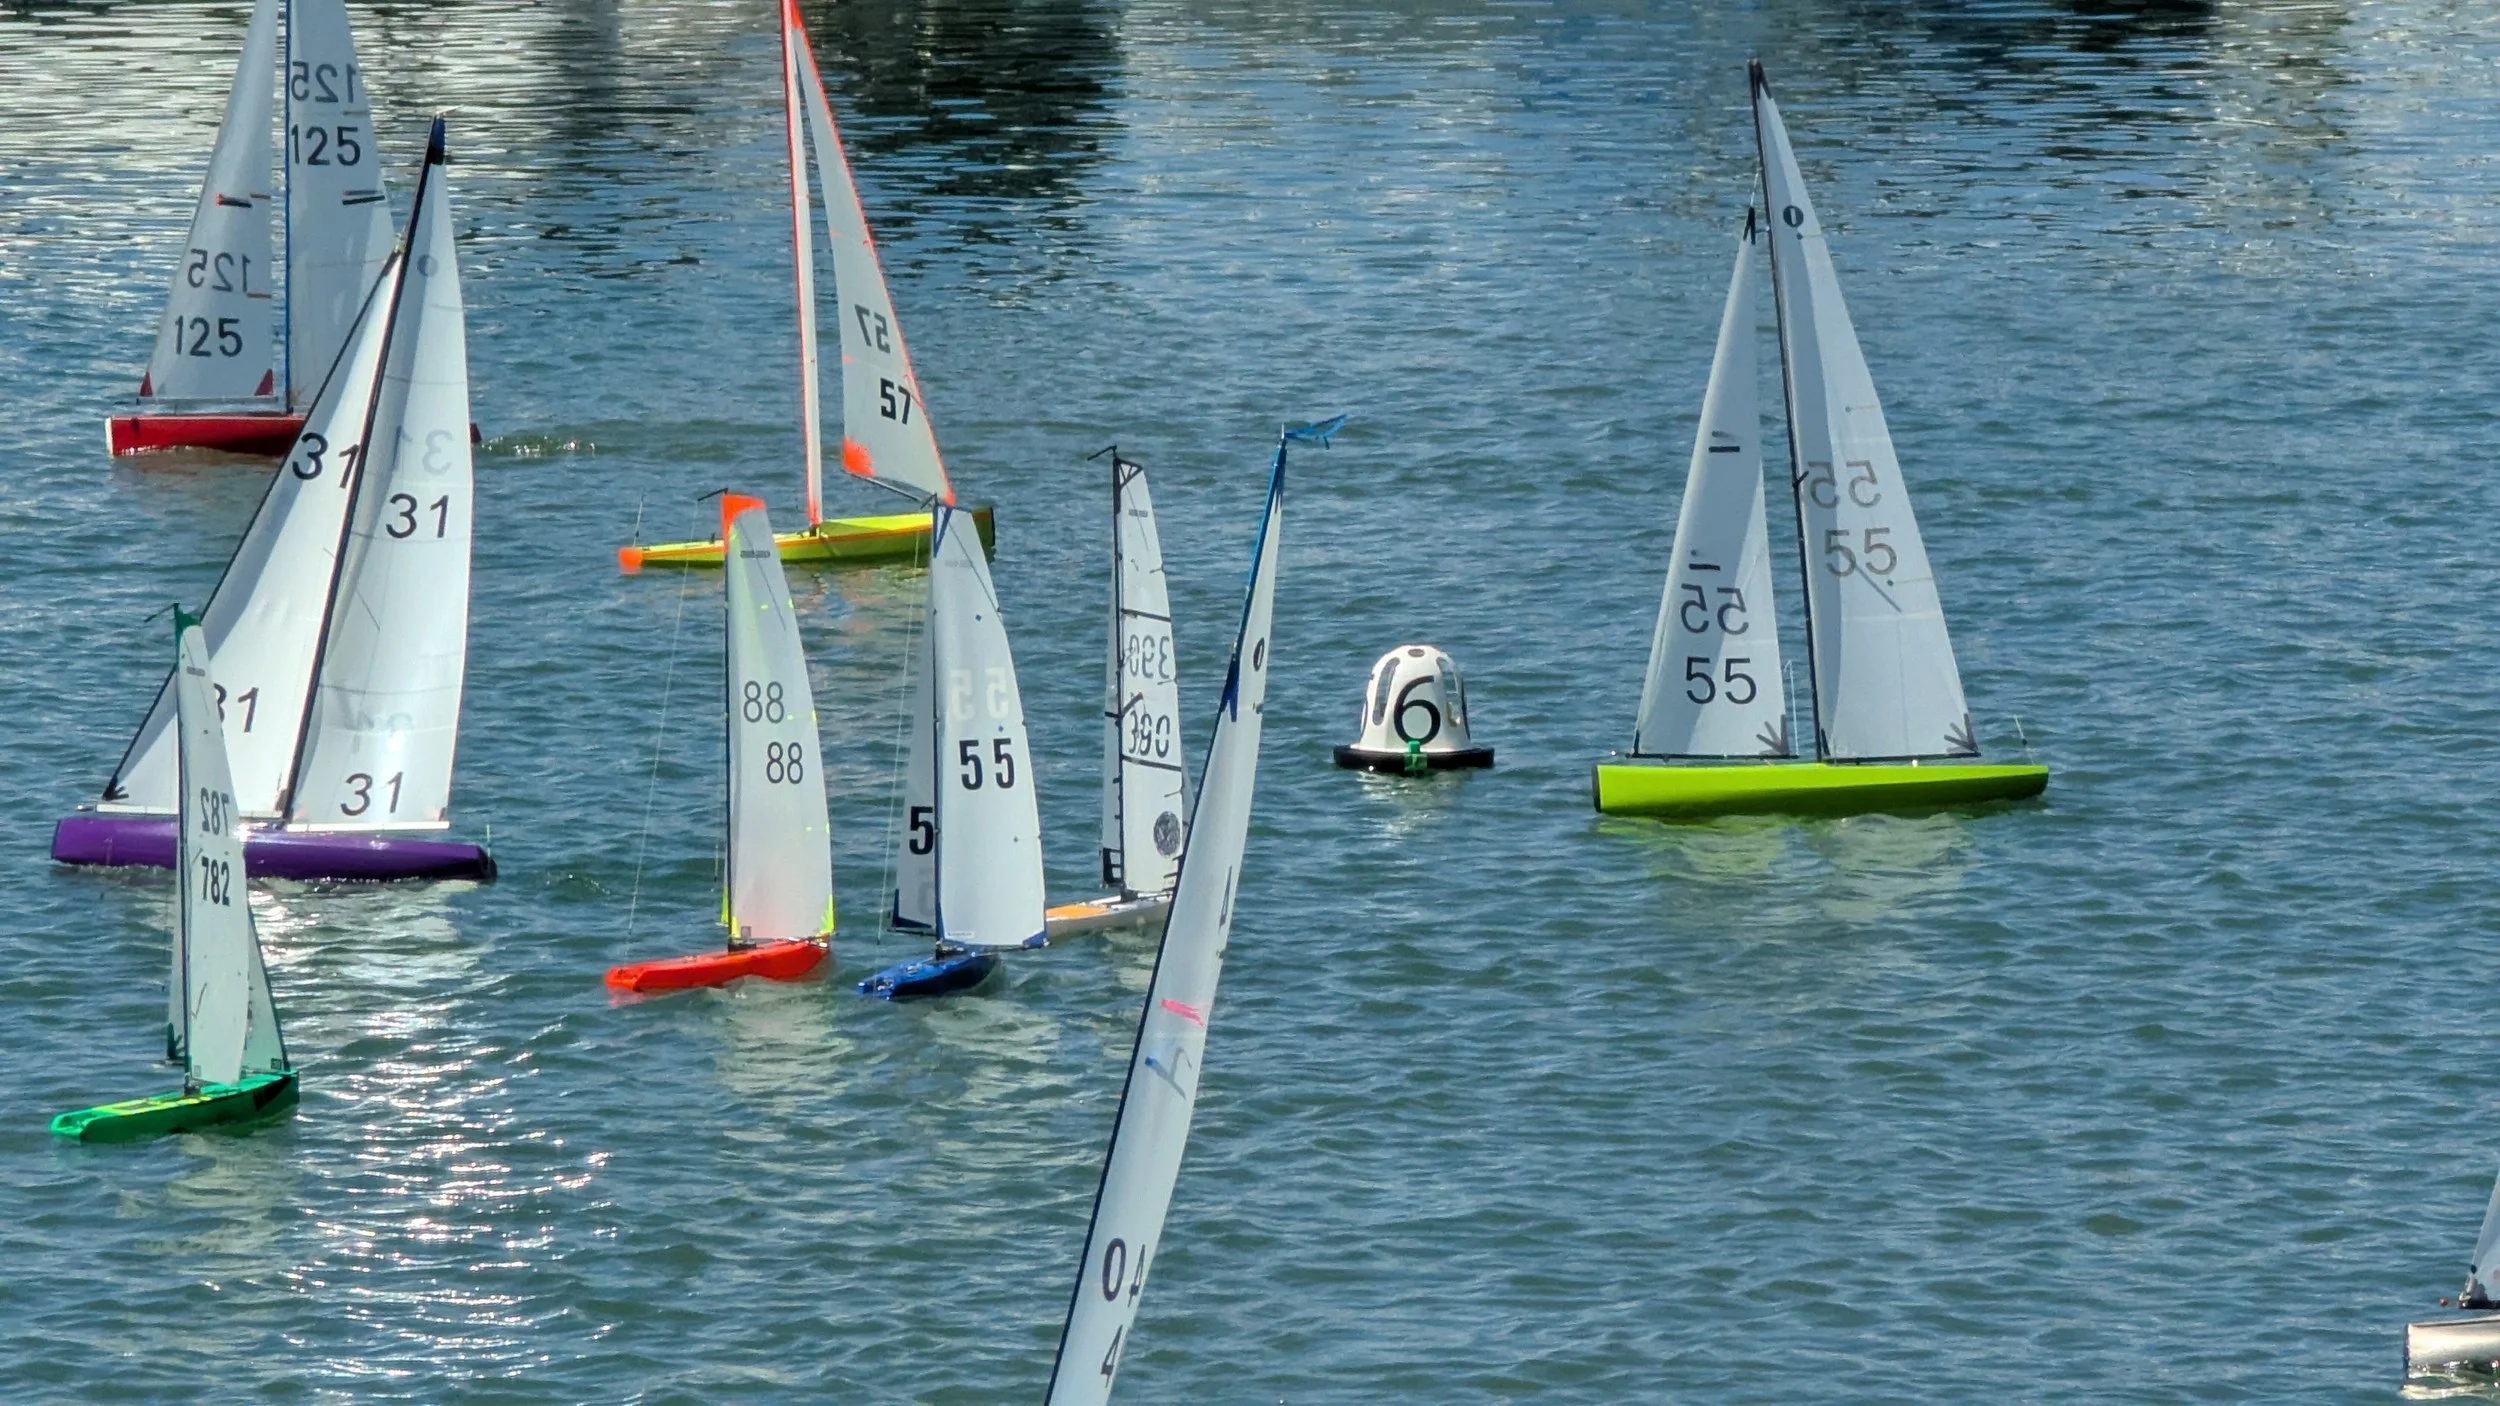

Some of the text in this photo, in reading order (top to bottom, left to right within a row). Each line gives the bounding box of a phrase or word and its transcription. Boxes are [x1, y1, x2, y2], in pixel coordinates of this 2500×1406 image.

[291, 126, 361, 166] 125
[174, 315, 243, 357] 125
[880, 377, 912, 425] 57
[292, 432, 360, 489] 31
[385, 493, 449, 538] 31
[1824, 527, 1898, 577] 55
[1685, 656, 1757, 705] 55
[1394, 675, 1441, 745] 6
[766, 741, 804, 784] 88
[958, 737, 1016, 790] 55
[340, 771, 404, 816] 31
[201, 856, 231, 906] 782
